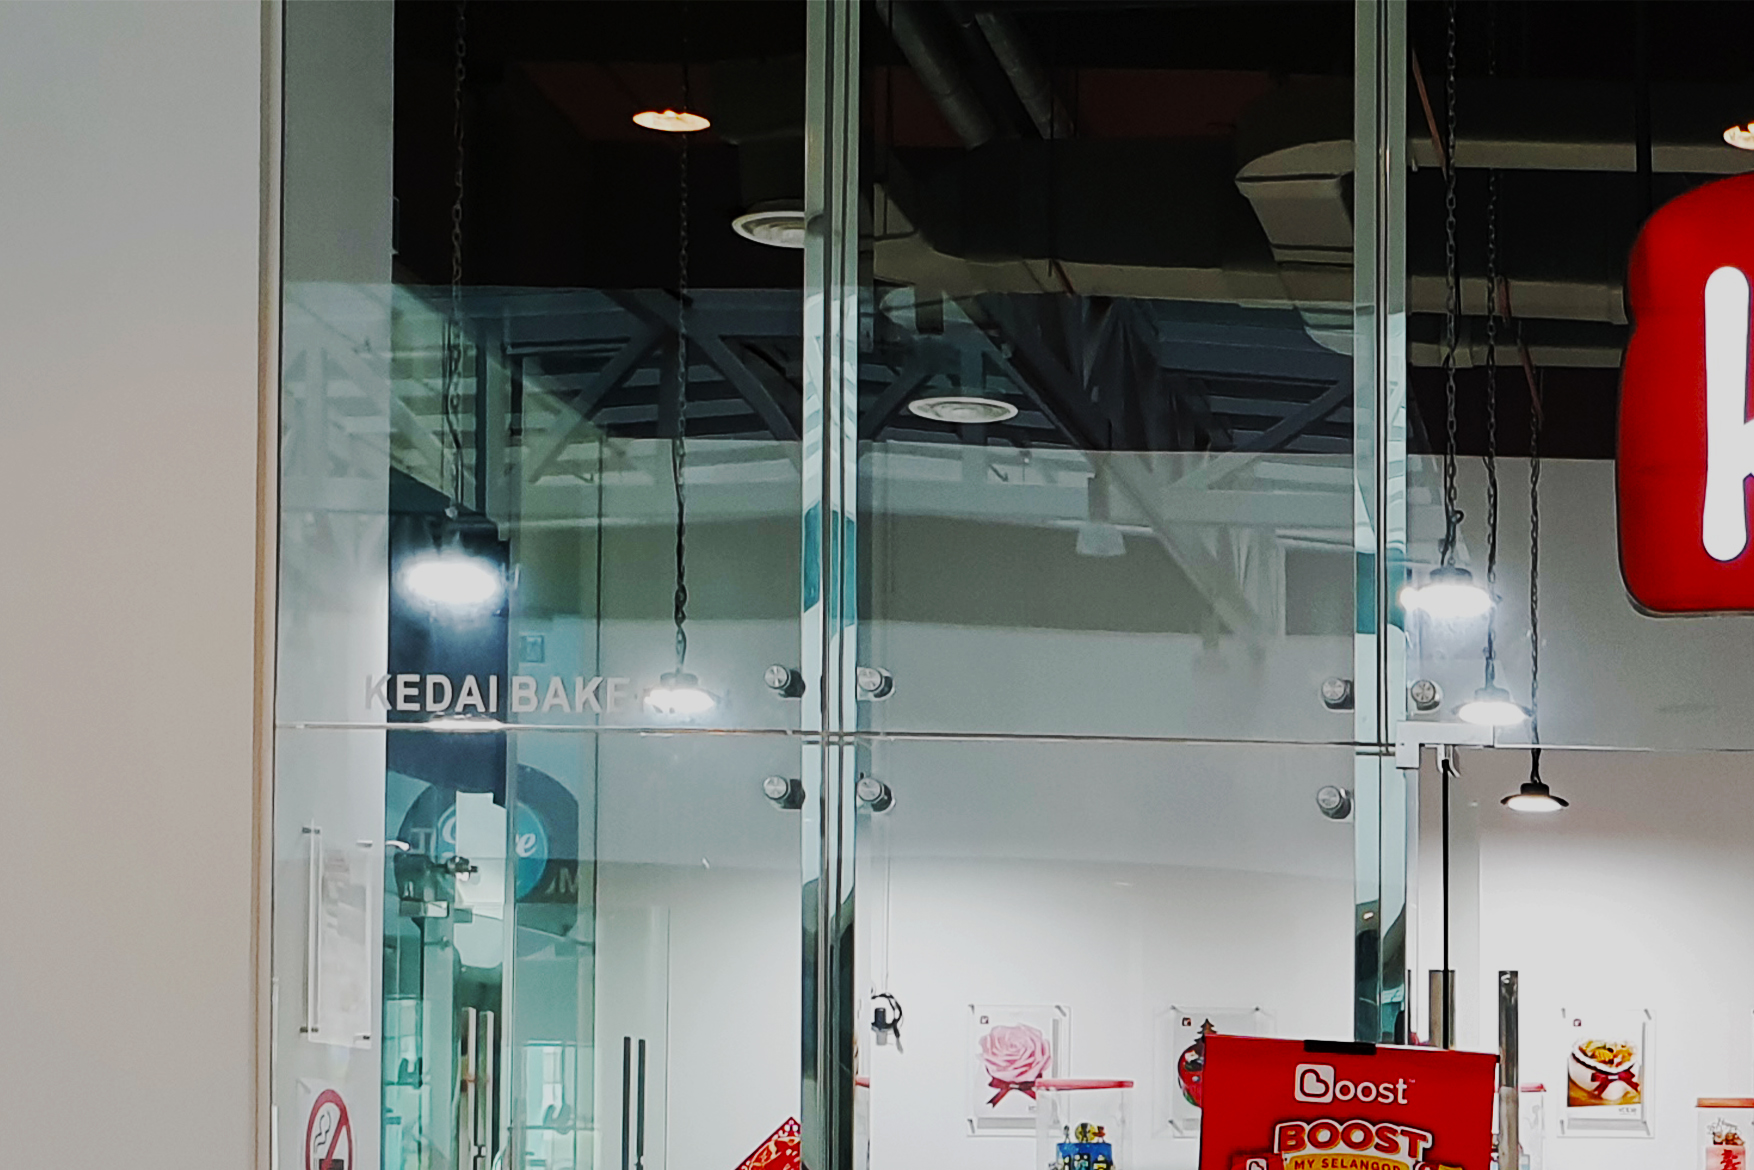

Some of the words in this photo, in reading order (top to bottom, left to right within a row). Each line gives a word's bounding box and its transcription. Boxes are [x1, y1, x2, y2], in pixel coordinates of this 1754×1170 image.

[364, 673, 499, 713] KEDAI
[511, 675, 634, 714] BAKE
[1279, 1120, 1428, 1160] BOOST
